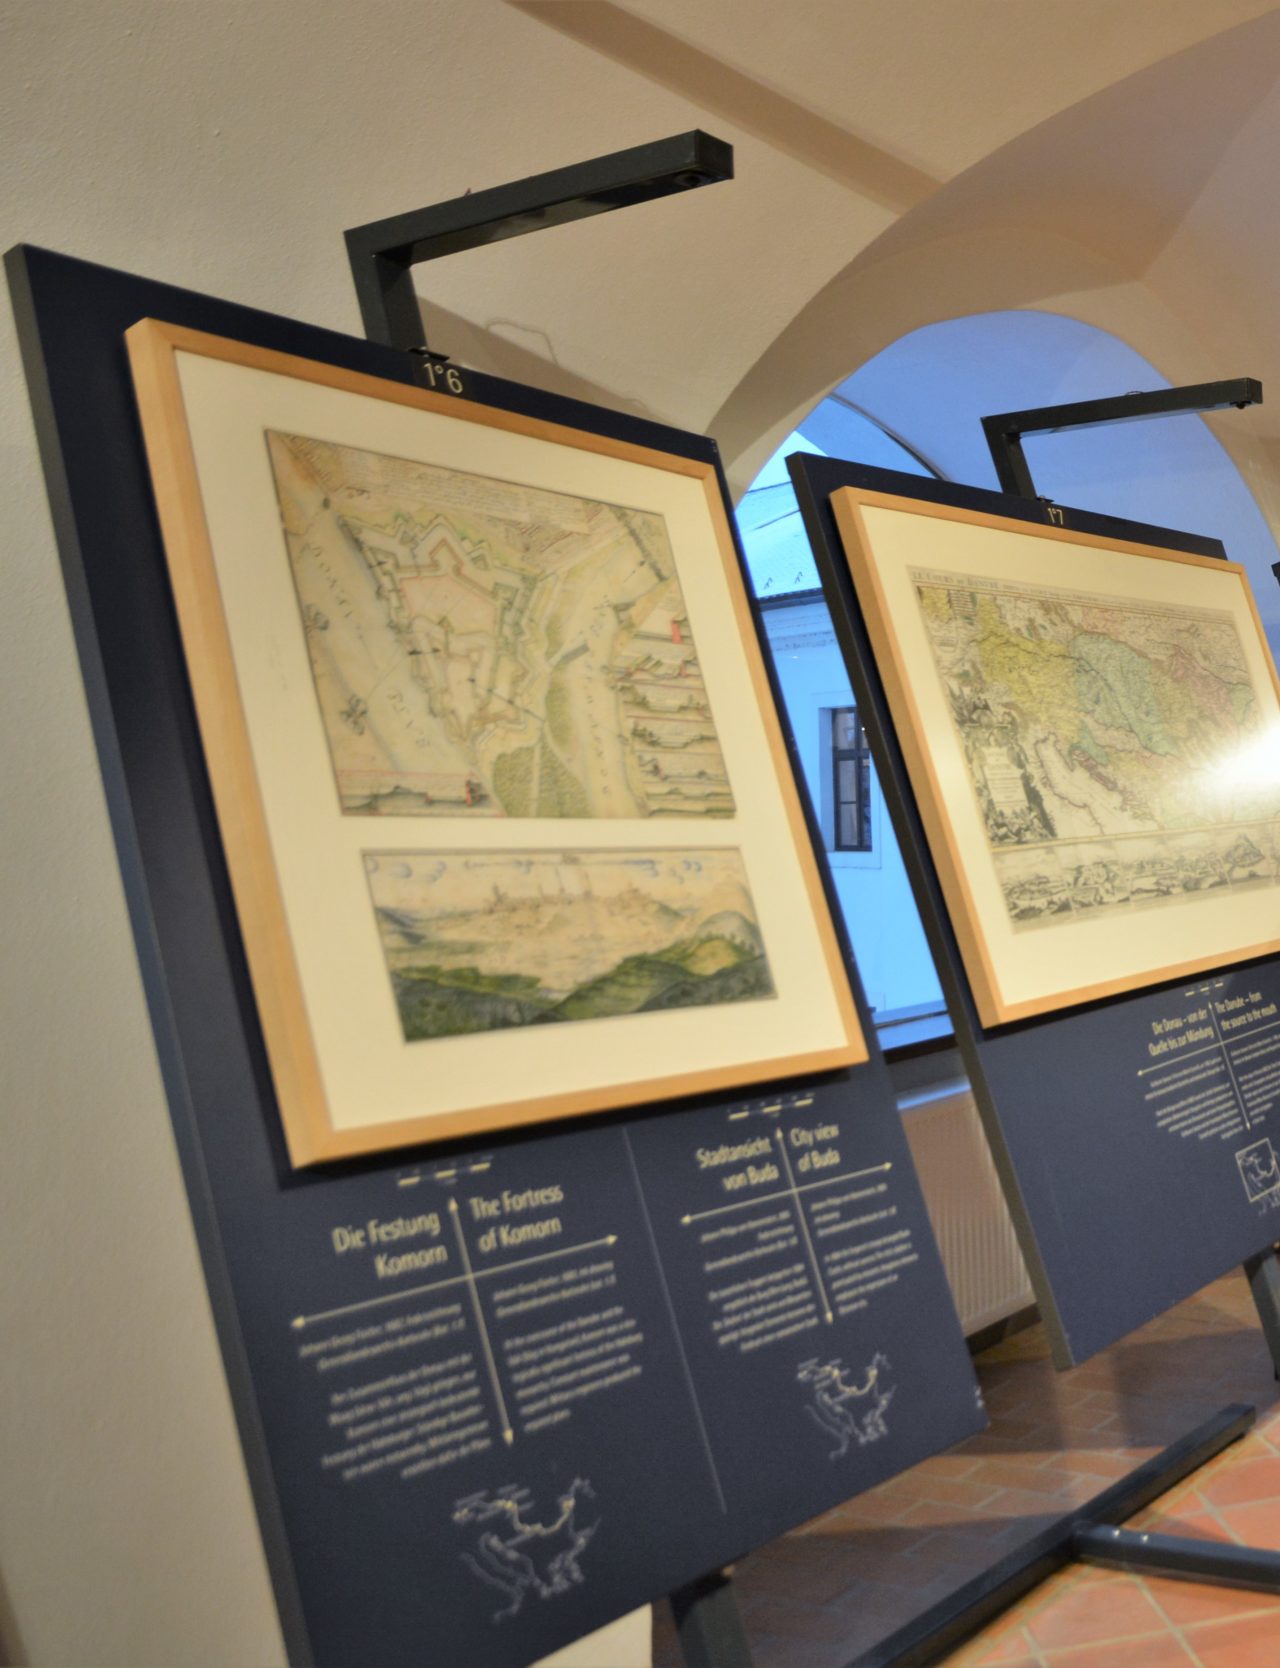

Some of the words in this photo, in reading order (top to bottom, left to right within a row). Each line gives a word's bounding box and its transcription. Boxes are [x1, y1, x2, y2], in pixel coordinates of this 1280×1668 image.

[790, 1127, 814, 1148] City
[814, 1122, 840, 1143] view
[722, 1172, 749, 1193] von
[746, 1162, 780, 1187] Buda
[798, 1151, 811, 1173] of
[810, 1147, 841, 1170] Buda
[469, 1196, 501, 1222] The
[502, 1184, 564, 1214] Fortress
[331, 1224, 367, 1255] Die
[367, 1211, 441, 1247] Festung
[478, 1226, 498, 1254] of
[499, 1216, 563, 1248] Komorn
[373, 1244, 449, 1280] Komorn
